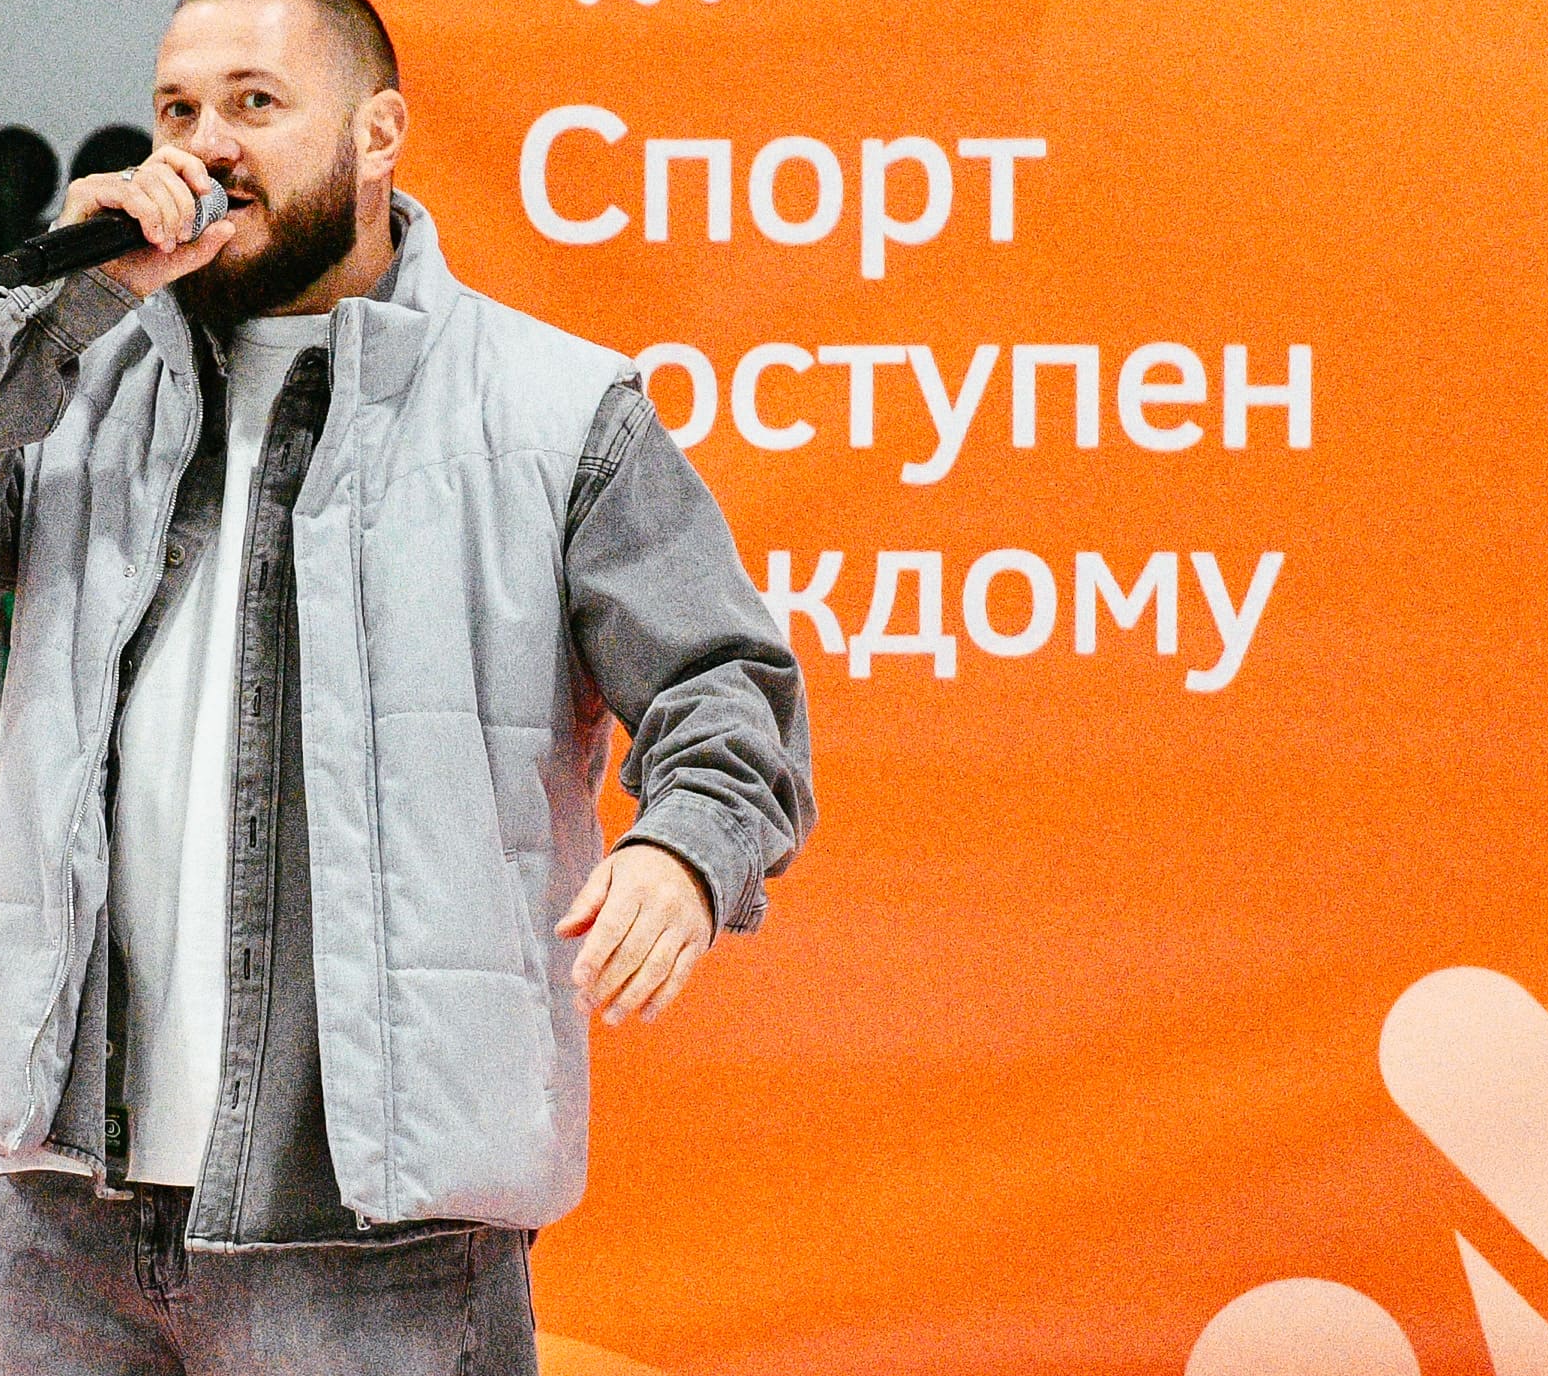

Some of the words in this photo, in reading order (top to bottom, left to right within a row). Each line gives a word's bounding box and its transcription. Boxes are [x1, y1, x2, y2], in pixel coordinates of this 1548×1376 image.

[518, 103, 1048, 281] Спорт
[633, 341, 1313, 486] оступен
[758, 547, 1285, 694] ждому
